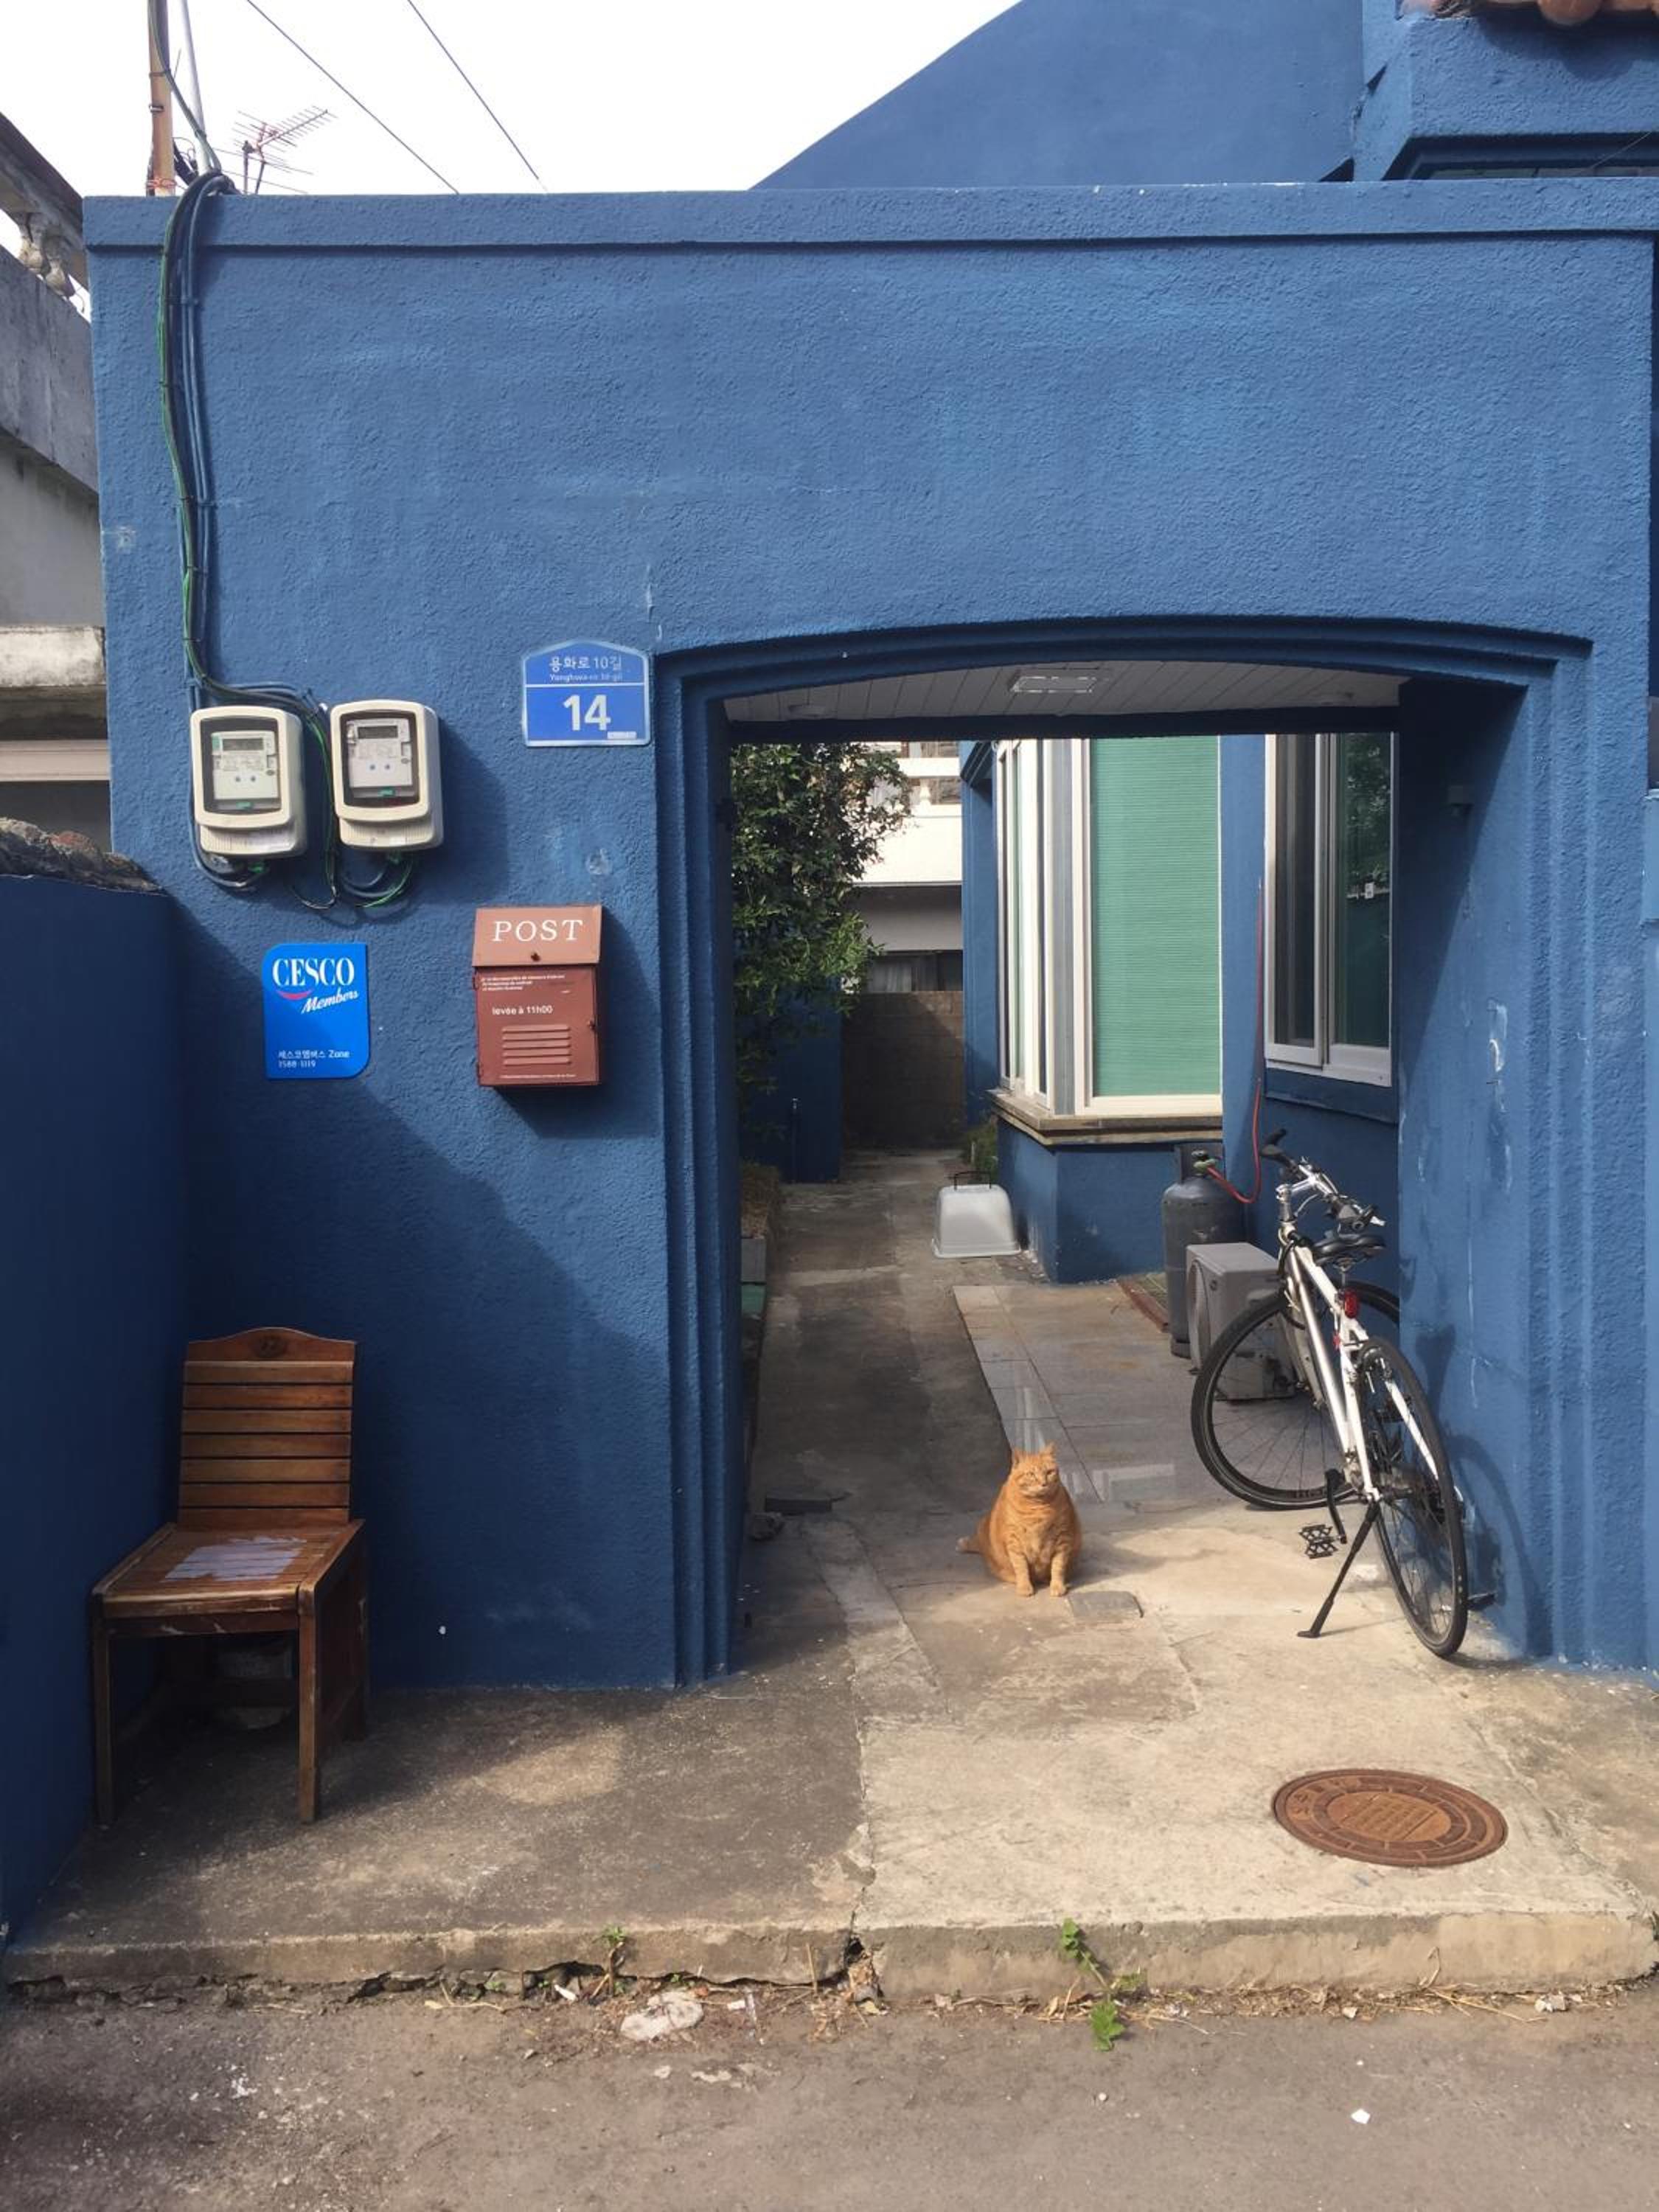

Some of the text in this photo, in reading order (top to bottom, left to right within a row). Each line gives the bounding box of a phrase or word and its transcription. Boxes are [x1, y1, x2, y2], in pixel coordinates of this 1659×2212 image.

[563, 694, 611, 731] 14
[492, 919, 583, 942] POST
[272, 957, 355, 987] CESCO
[301, 987, 359, 1014] Members
[526, 1004, 554, 1014] 11h00
[328, 1049, 350, 1058] Zone
